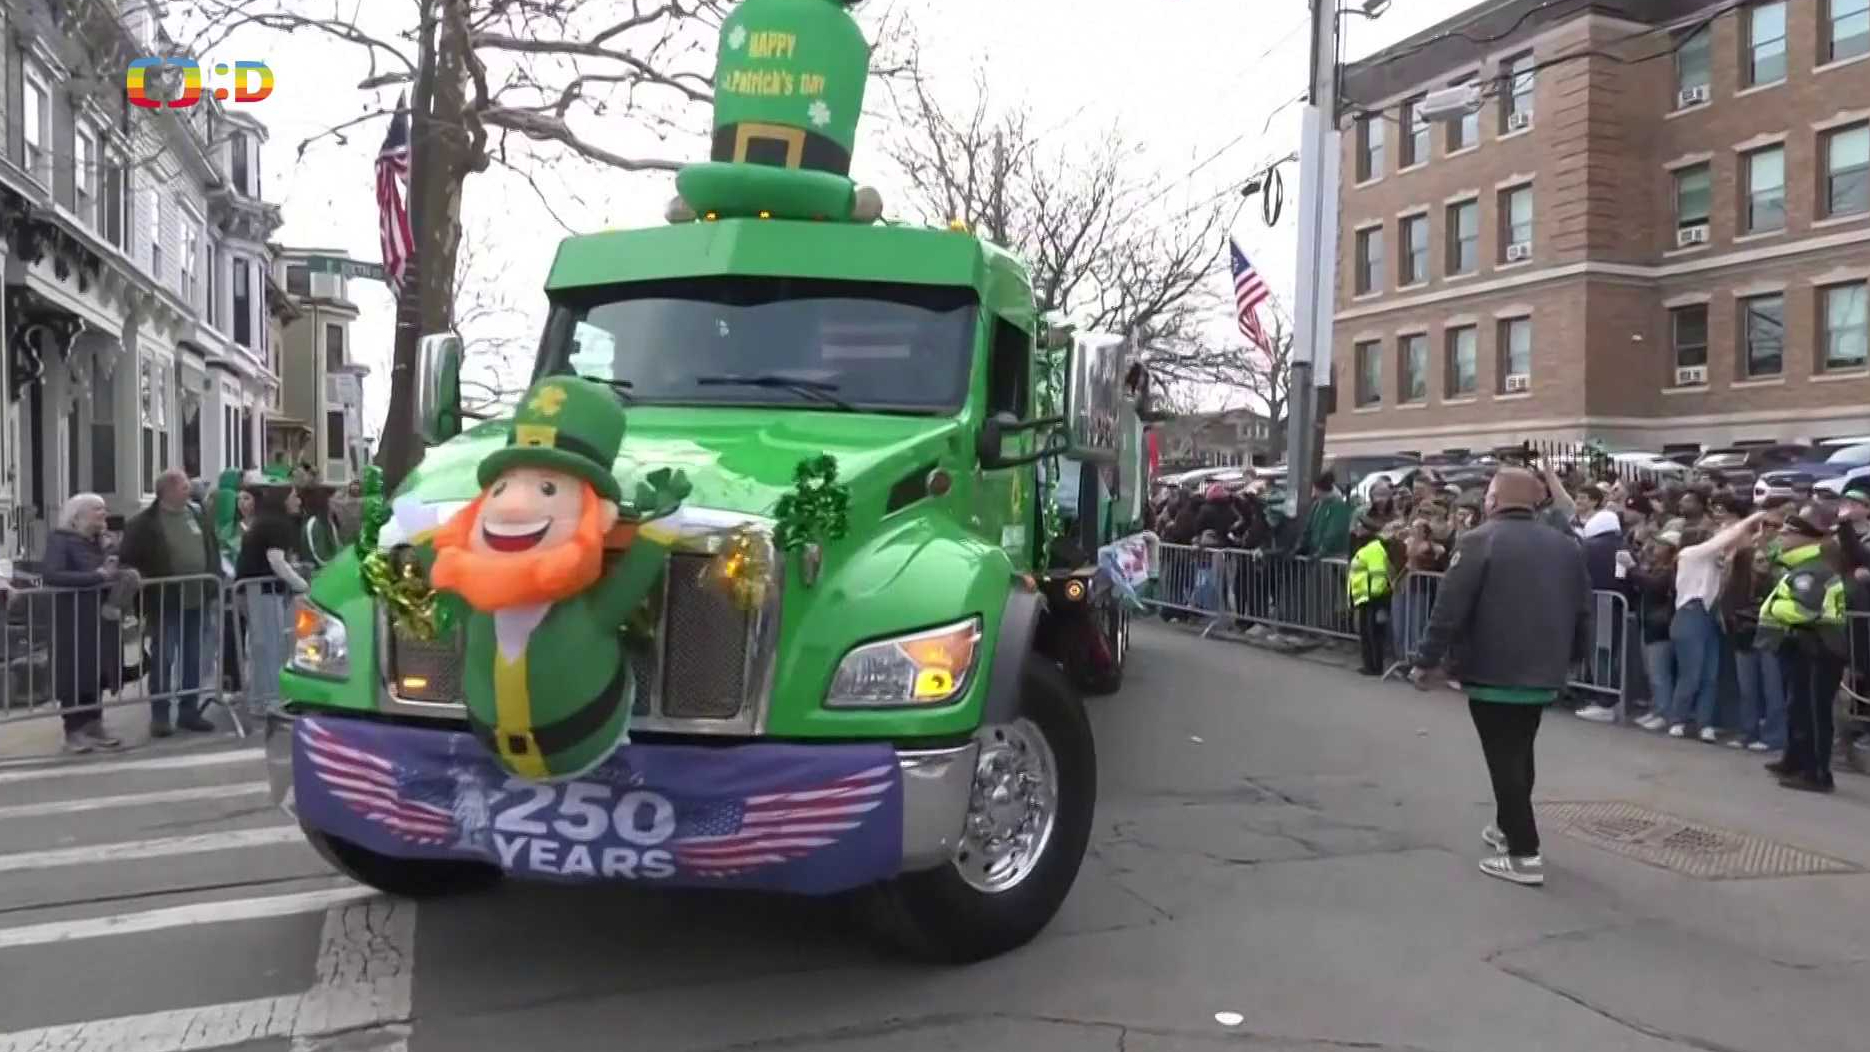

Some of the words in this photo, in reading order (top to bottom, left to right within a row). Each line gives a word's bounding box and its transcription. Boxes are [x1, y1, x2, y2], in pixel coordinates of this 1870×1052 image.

[749, 31, 796, 58] HAPPY
[494, 780, 676, 846] 250
[493, 832, 677, 878] YEARS
